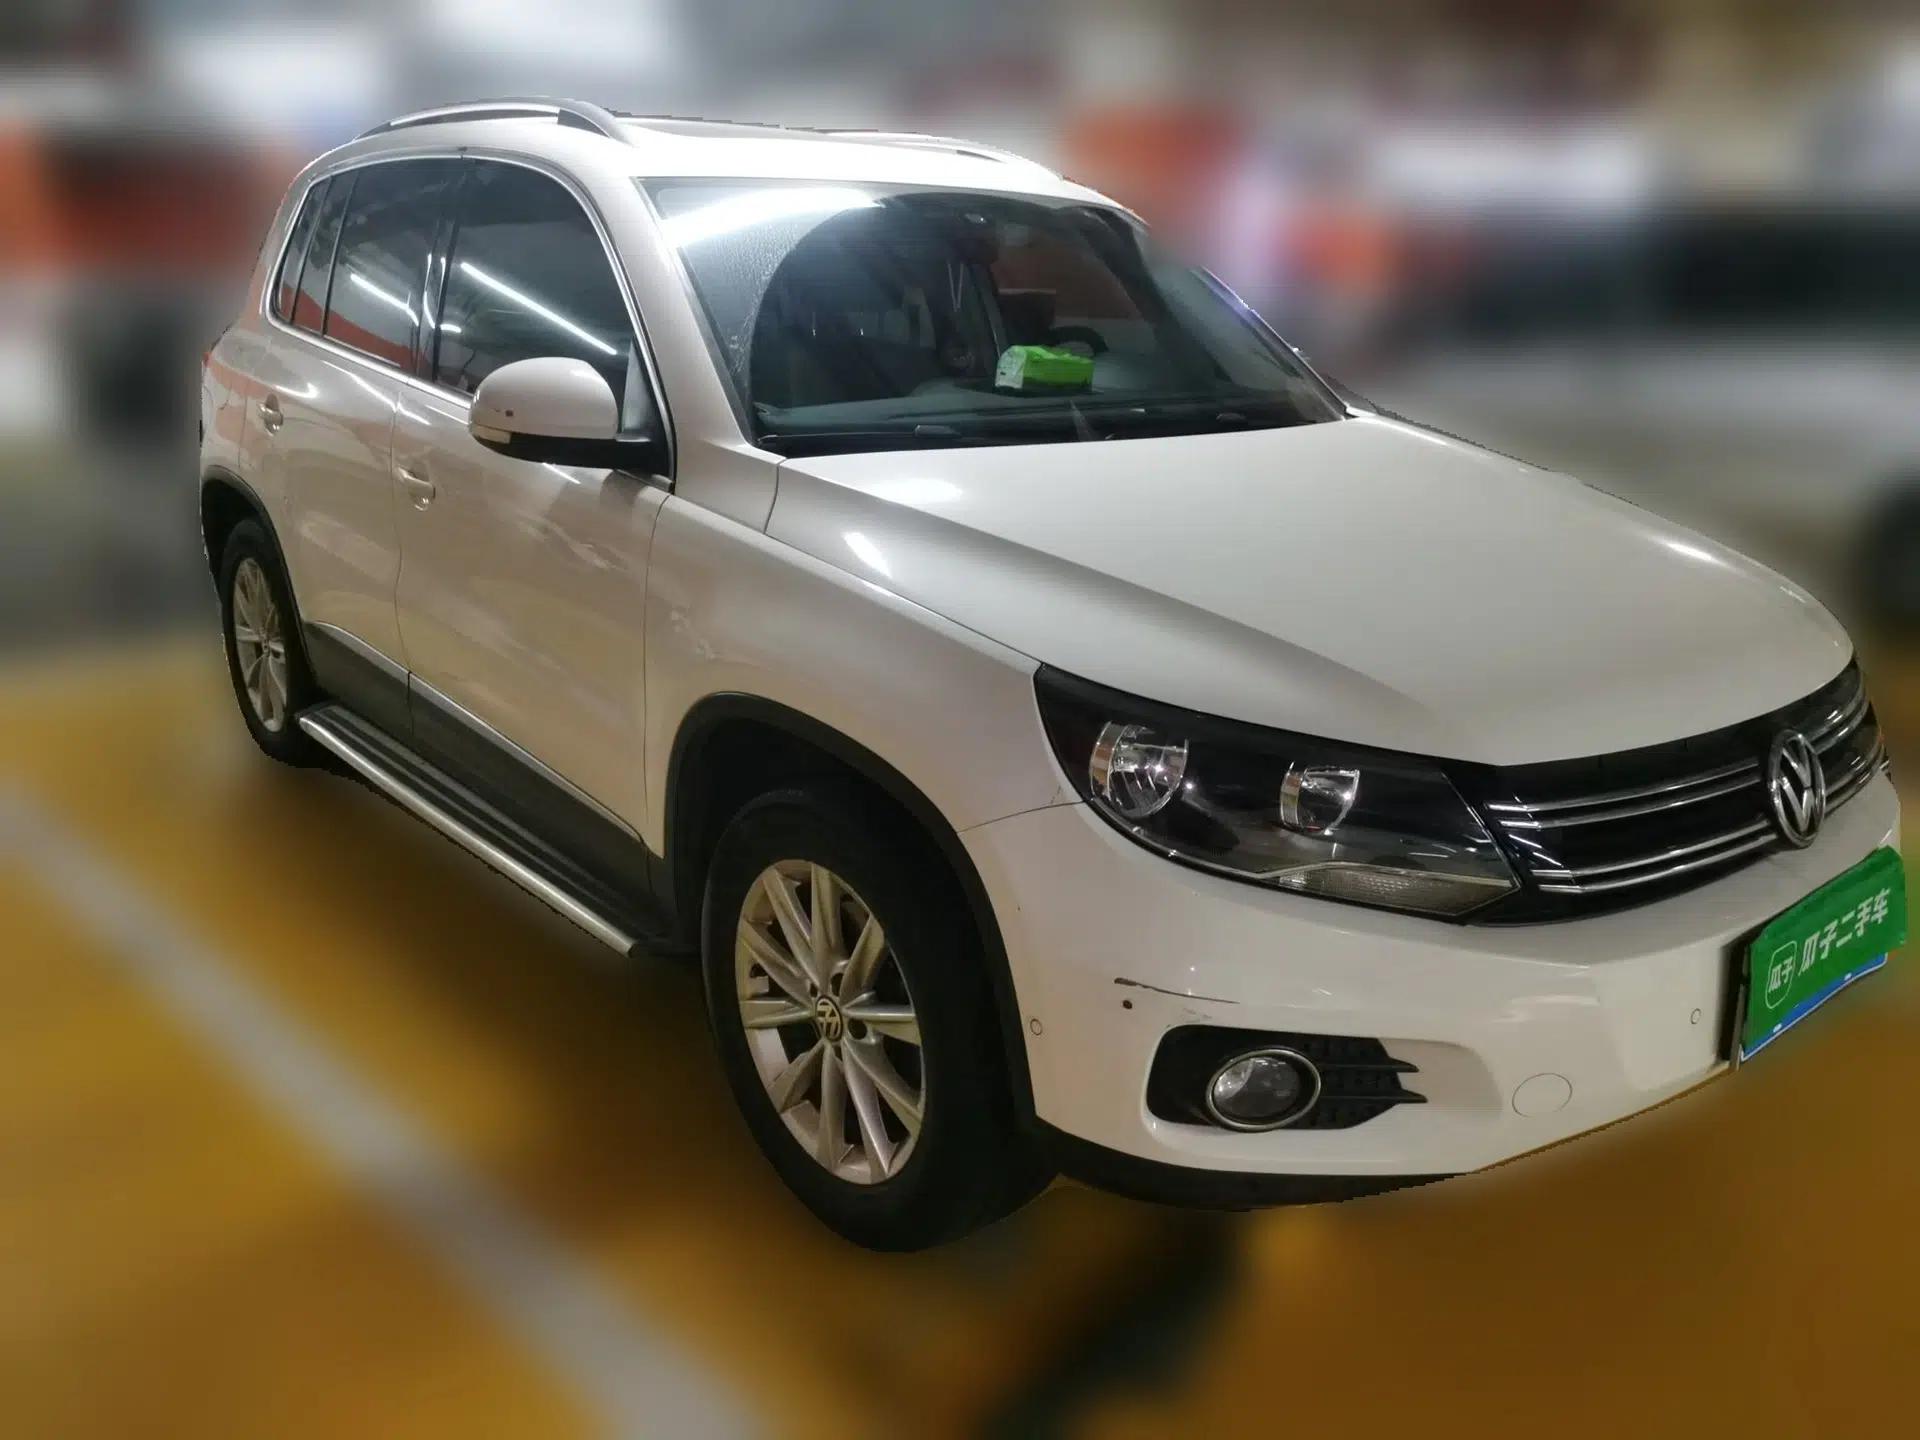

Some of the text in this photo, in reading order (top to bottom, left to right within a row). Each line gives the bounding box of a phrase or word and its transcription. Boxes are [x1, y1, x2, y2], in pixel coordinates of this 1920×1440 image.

[1769, 887, 1891, 992] 瓜子 瓜子二手车
